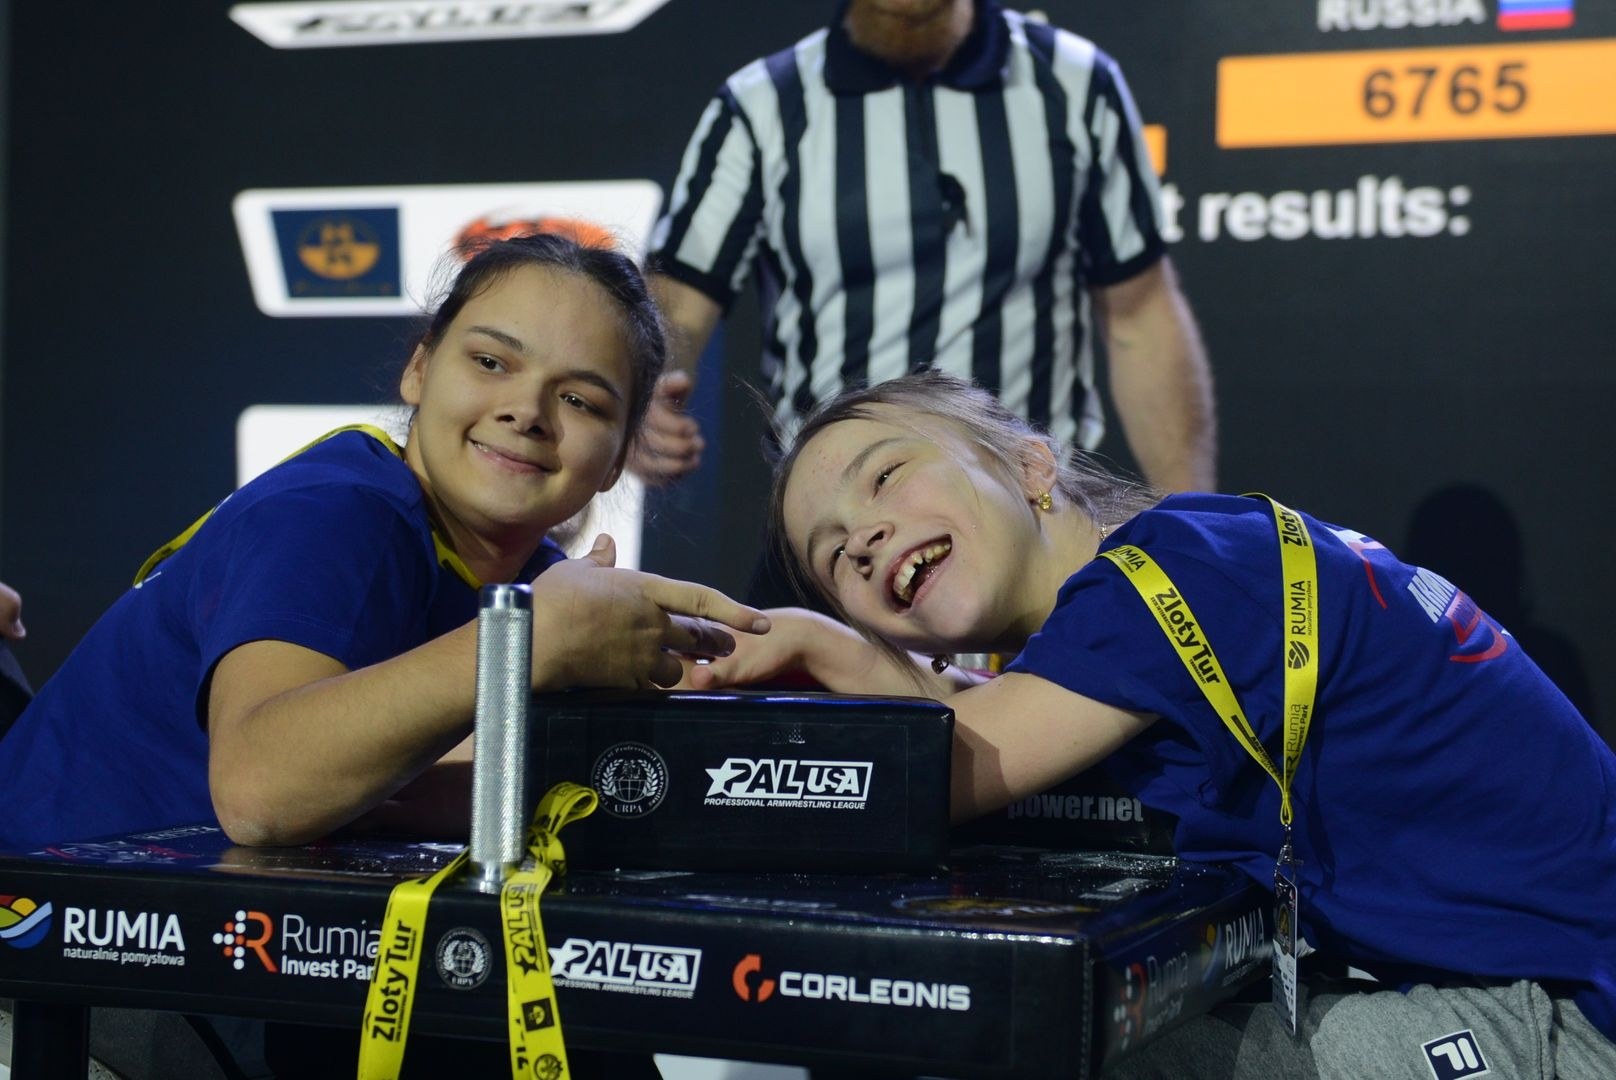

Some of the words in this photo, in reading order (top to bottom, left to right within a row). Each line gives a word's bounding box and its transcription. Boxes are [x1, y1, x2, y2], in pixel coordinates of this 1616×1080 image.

[1361, 61, 1530, 119] 6765
[1198, 174, 1472, 243] results:
[1113, 547, 1147, 572] UMIA
[1290, 580, 1306, 636] RUMIA
[704, 797, 765, 807] PROFESSIONAL
[767, 799, 831, 809] ARMWRESTLING
[833, 801, 865, 810] LEAGUE
[64, 907, 186, 951] RUMIA
[281, 914, 383, 959] Rumia
[1224, 908, 1266, 970] RUMIA
[64, 948, 119, 961] naturalnie
[281, 955, 339, 978] Invest
[343, 959, 375, 981] Par
[780, 971, 971, 1012] CORLEONIS
